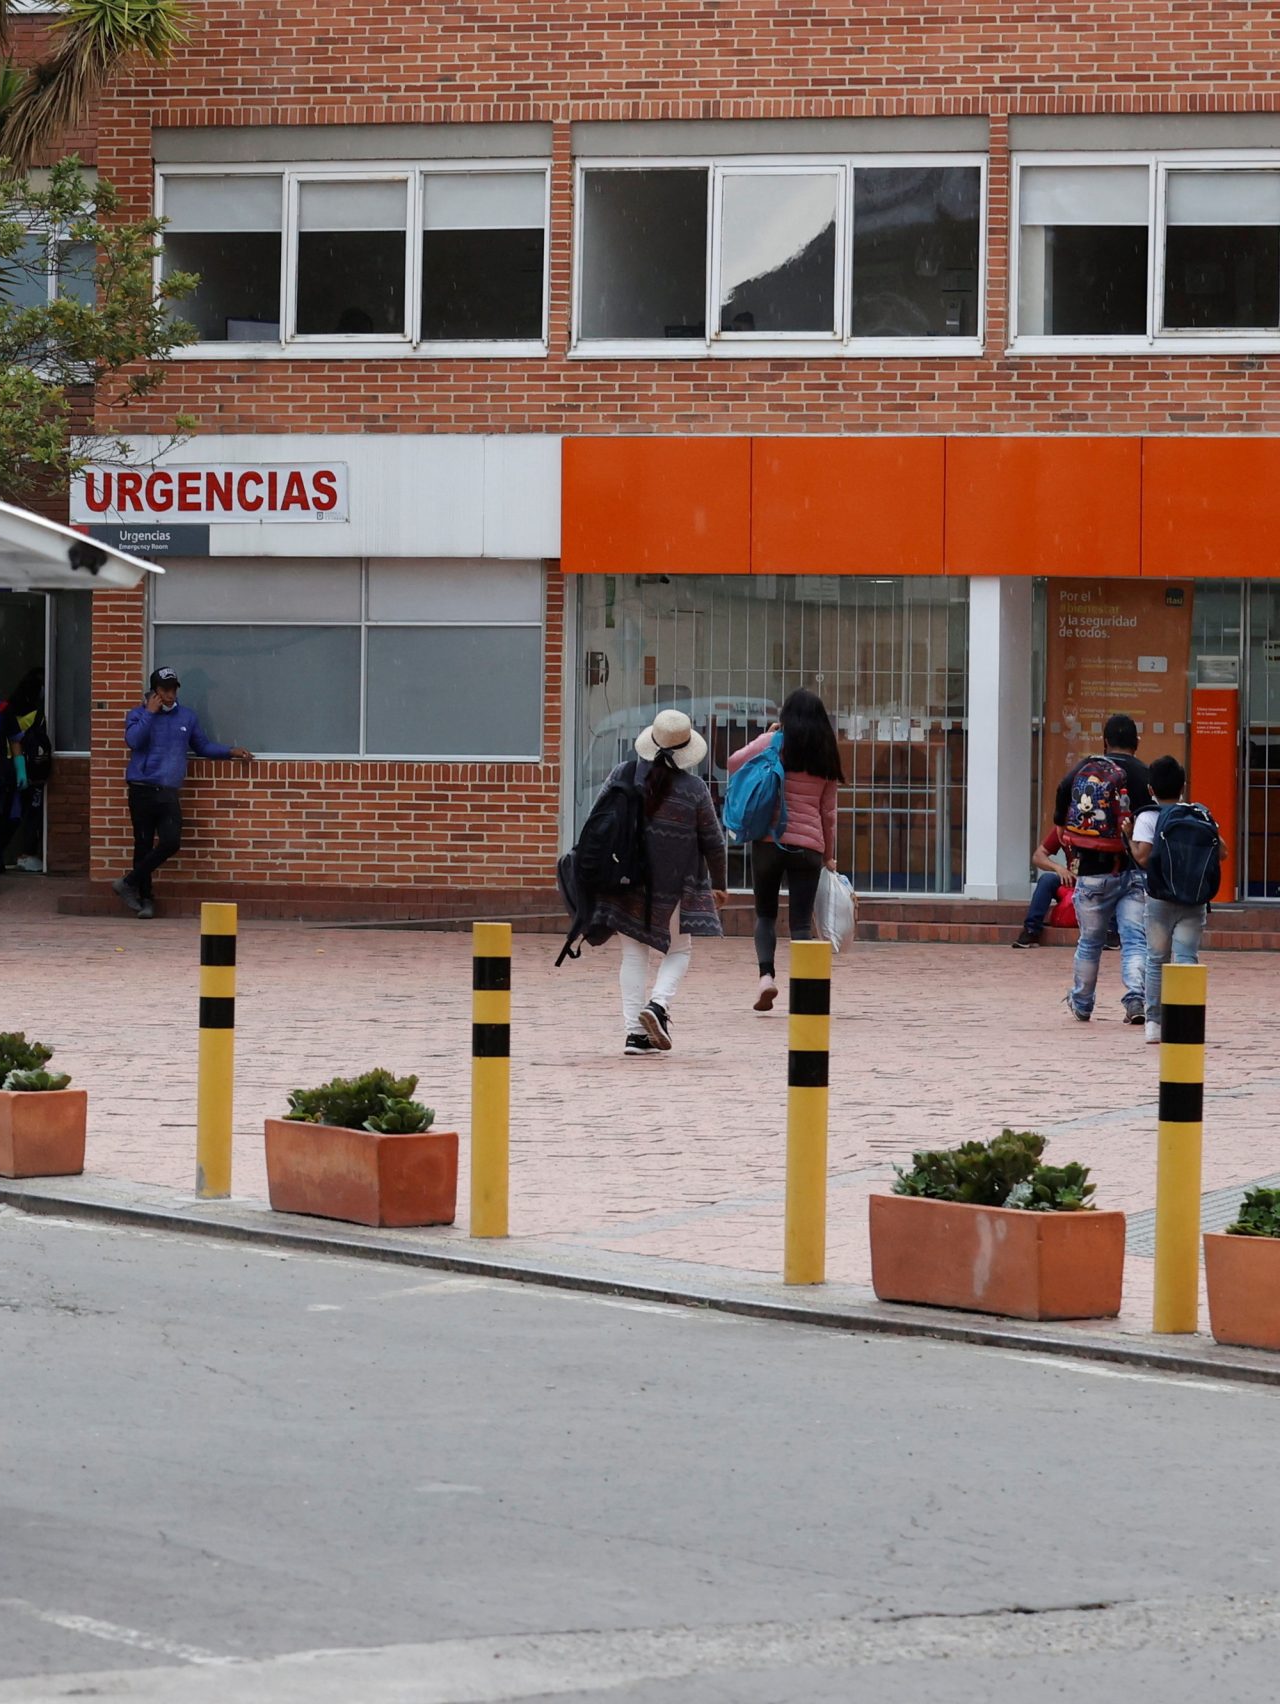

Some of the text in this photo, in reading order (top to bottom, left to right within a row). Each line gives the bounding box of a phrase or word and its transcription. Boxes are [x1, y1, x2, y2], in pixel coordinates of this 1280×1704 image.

[84, 470, 338, 513] URGENCIAS
[119, 530, 171, 543] Urgencias
[118, 543, 150, 551] Emergency
[1059, 590, 1091, 602] Por el
[1059, 615, 1137, 628] y la seguridad
[1058, 627, 1111, 639] de todos.
